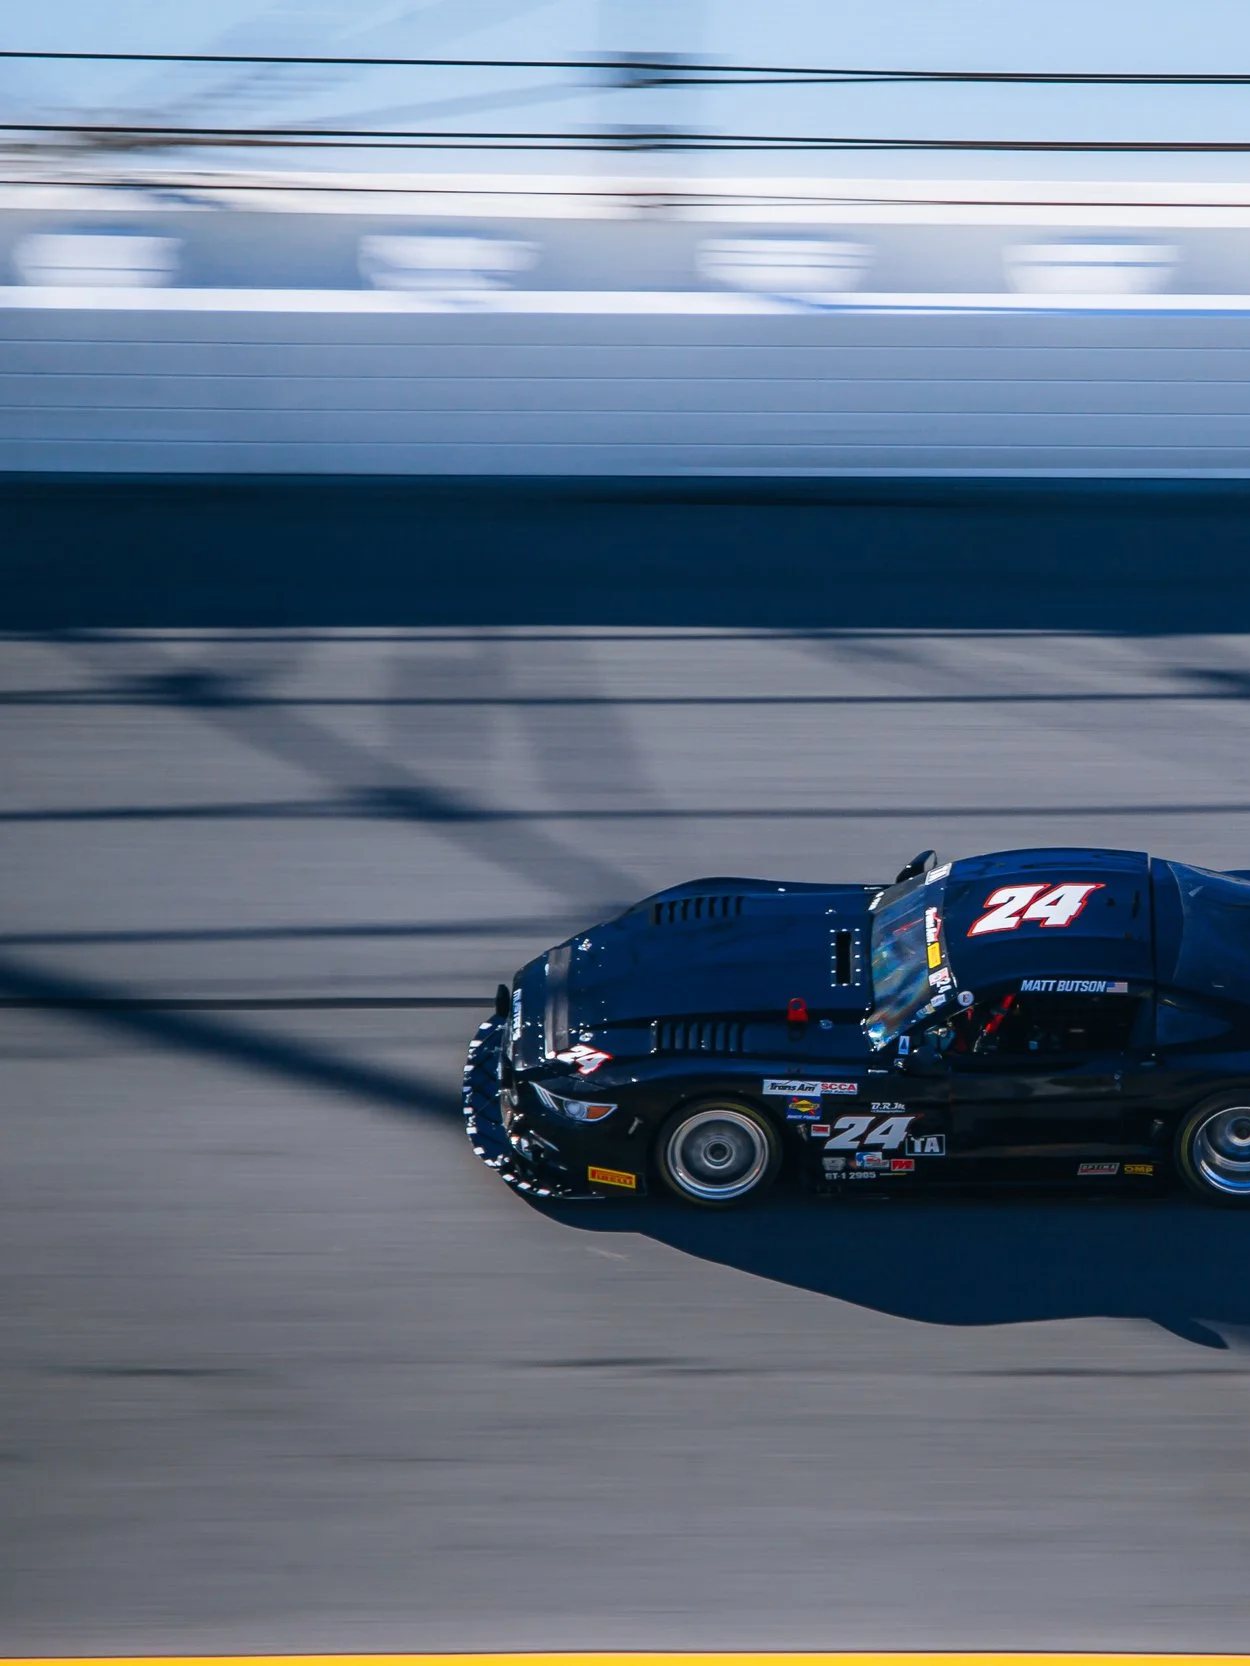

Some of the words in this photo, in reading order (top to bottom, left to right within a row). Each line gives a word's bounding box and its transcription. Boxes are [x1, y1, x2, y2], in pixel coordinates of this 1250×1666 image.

[967, 883, 1106, 937] 24
[936, 977, 952, 994] 24
[1021, 980, 1057, 992] MATT
[1056, 980, 1106, 993] BUTSON
[556, 1044, 614, 1075] 24
[769, 1082, 797, 1092] Trans
[797, 1082, 817, 1092] Am
[821, 1083, 856, 1091] SCCA
[823, 1115, 920, 1150] 24
[1124, 1165, 1153, 1173] OMP
